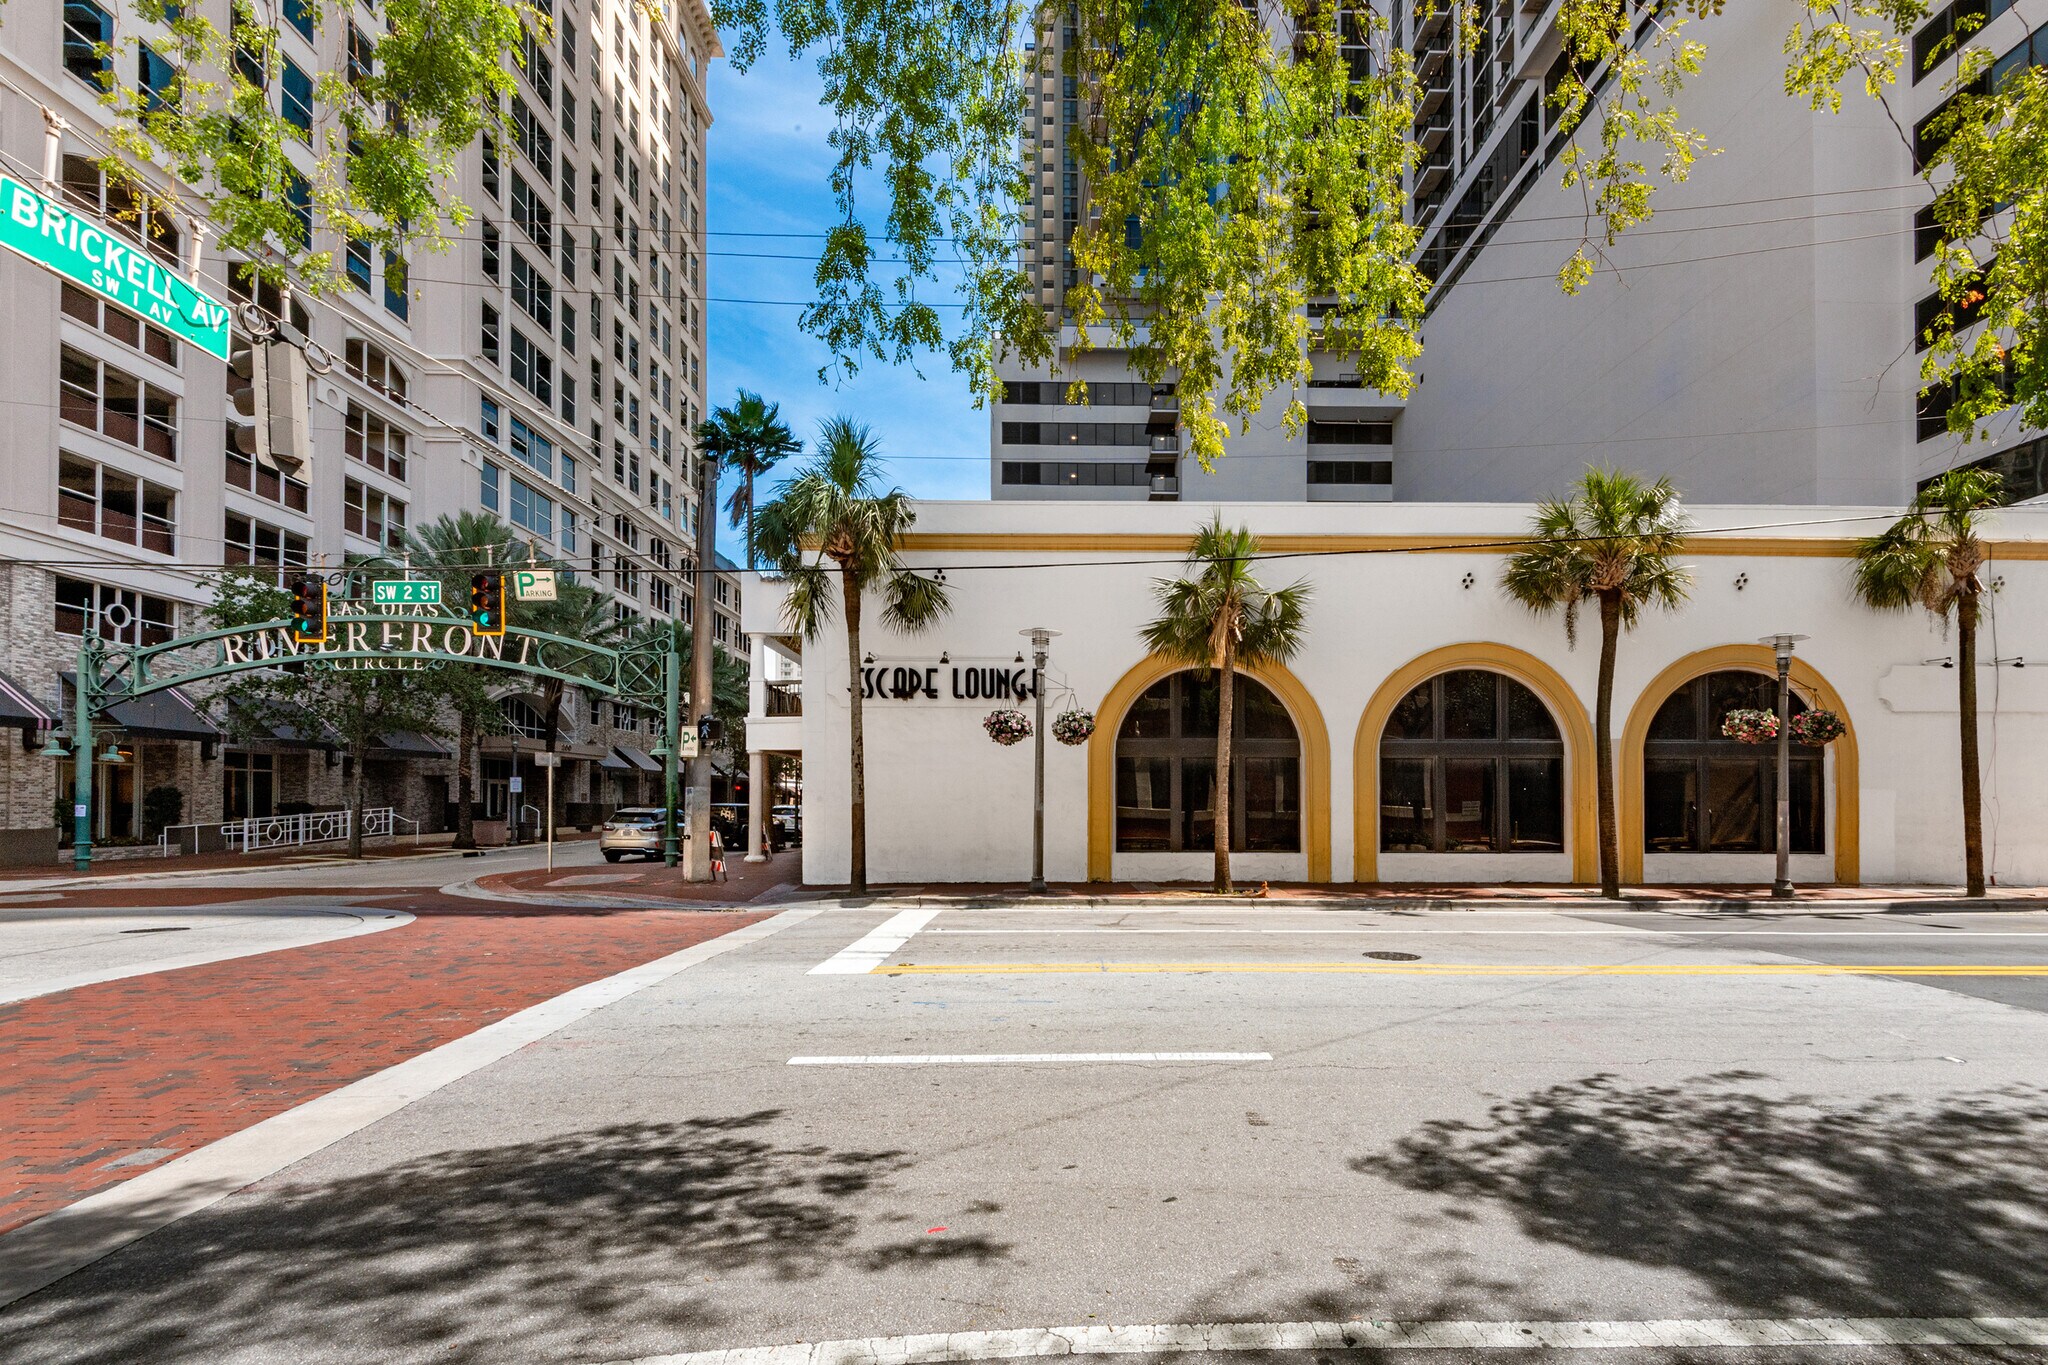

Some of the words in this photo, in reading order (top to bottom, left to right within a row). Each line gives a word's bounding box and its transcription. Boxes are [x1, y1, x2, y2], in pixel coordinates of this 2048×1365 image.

[11, 187, 180, 309] BRICKELL
[191, 296, 224, 333] AV
[91, 269, 120, 296] SW
[133, 290, 139, 306] 1
[149, 302, 172, 323] AV
[377, 585, 396, 600] SW
[403, 585, 413, 600] 2
[420, 585, 437, 600] ST
[327, 601, 368, 618] LAS
[381, 603, 439, 618] OLAS
[335, 658, 424, 671] CIRCLE
